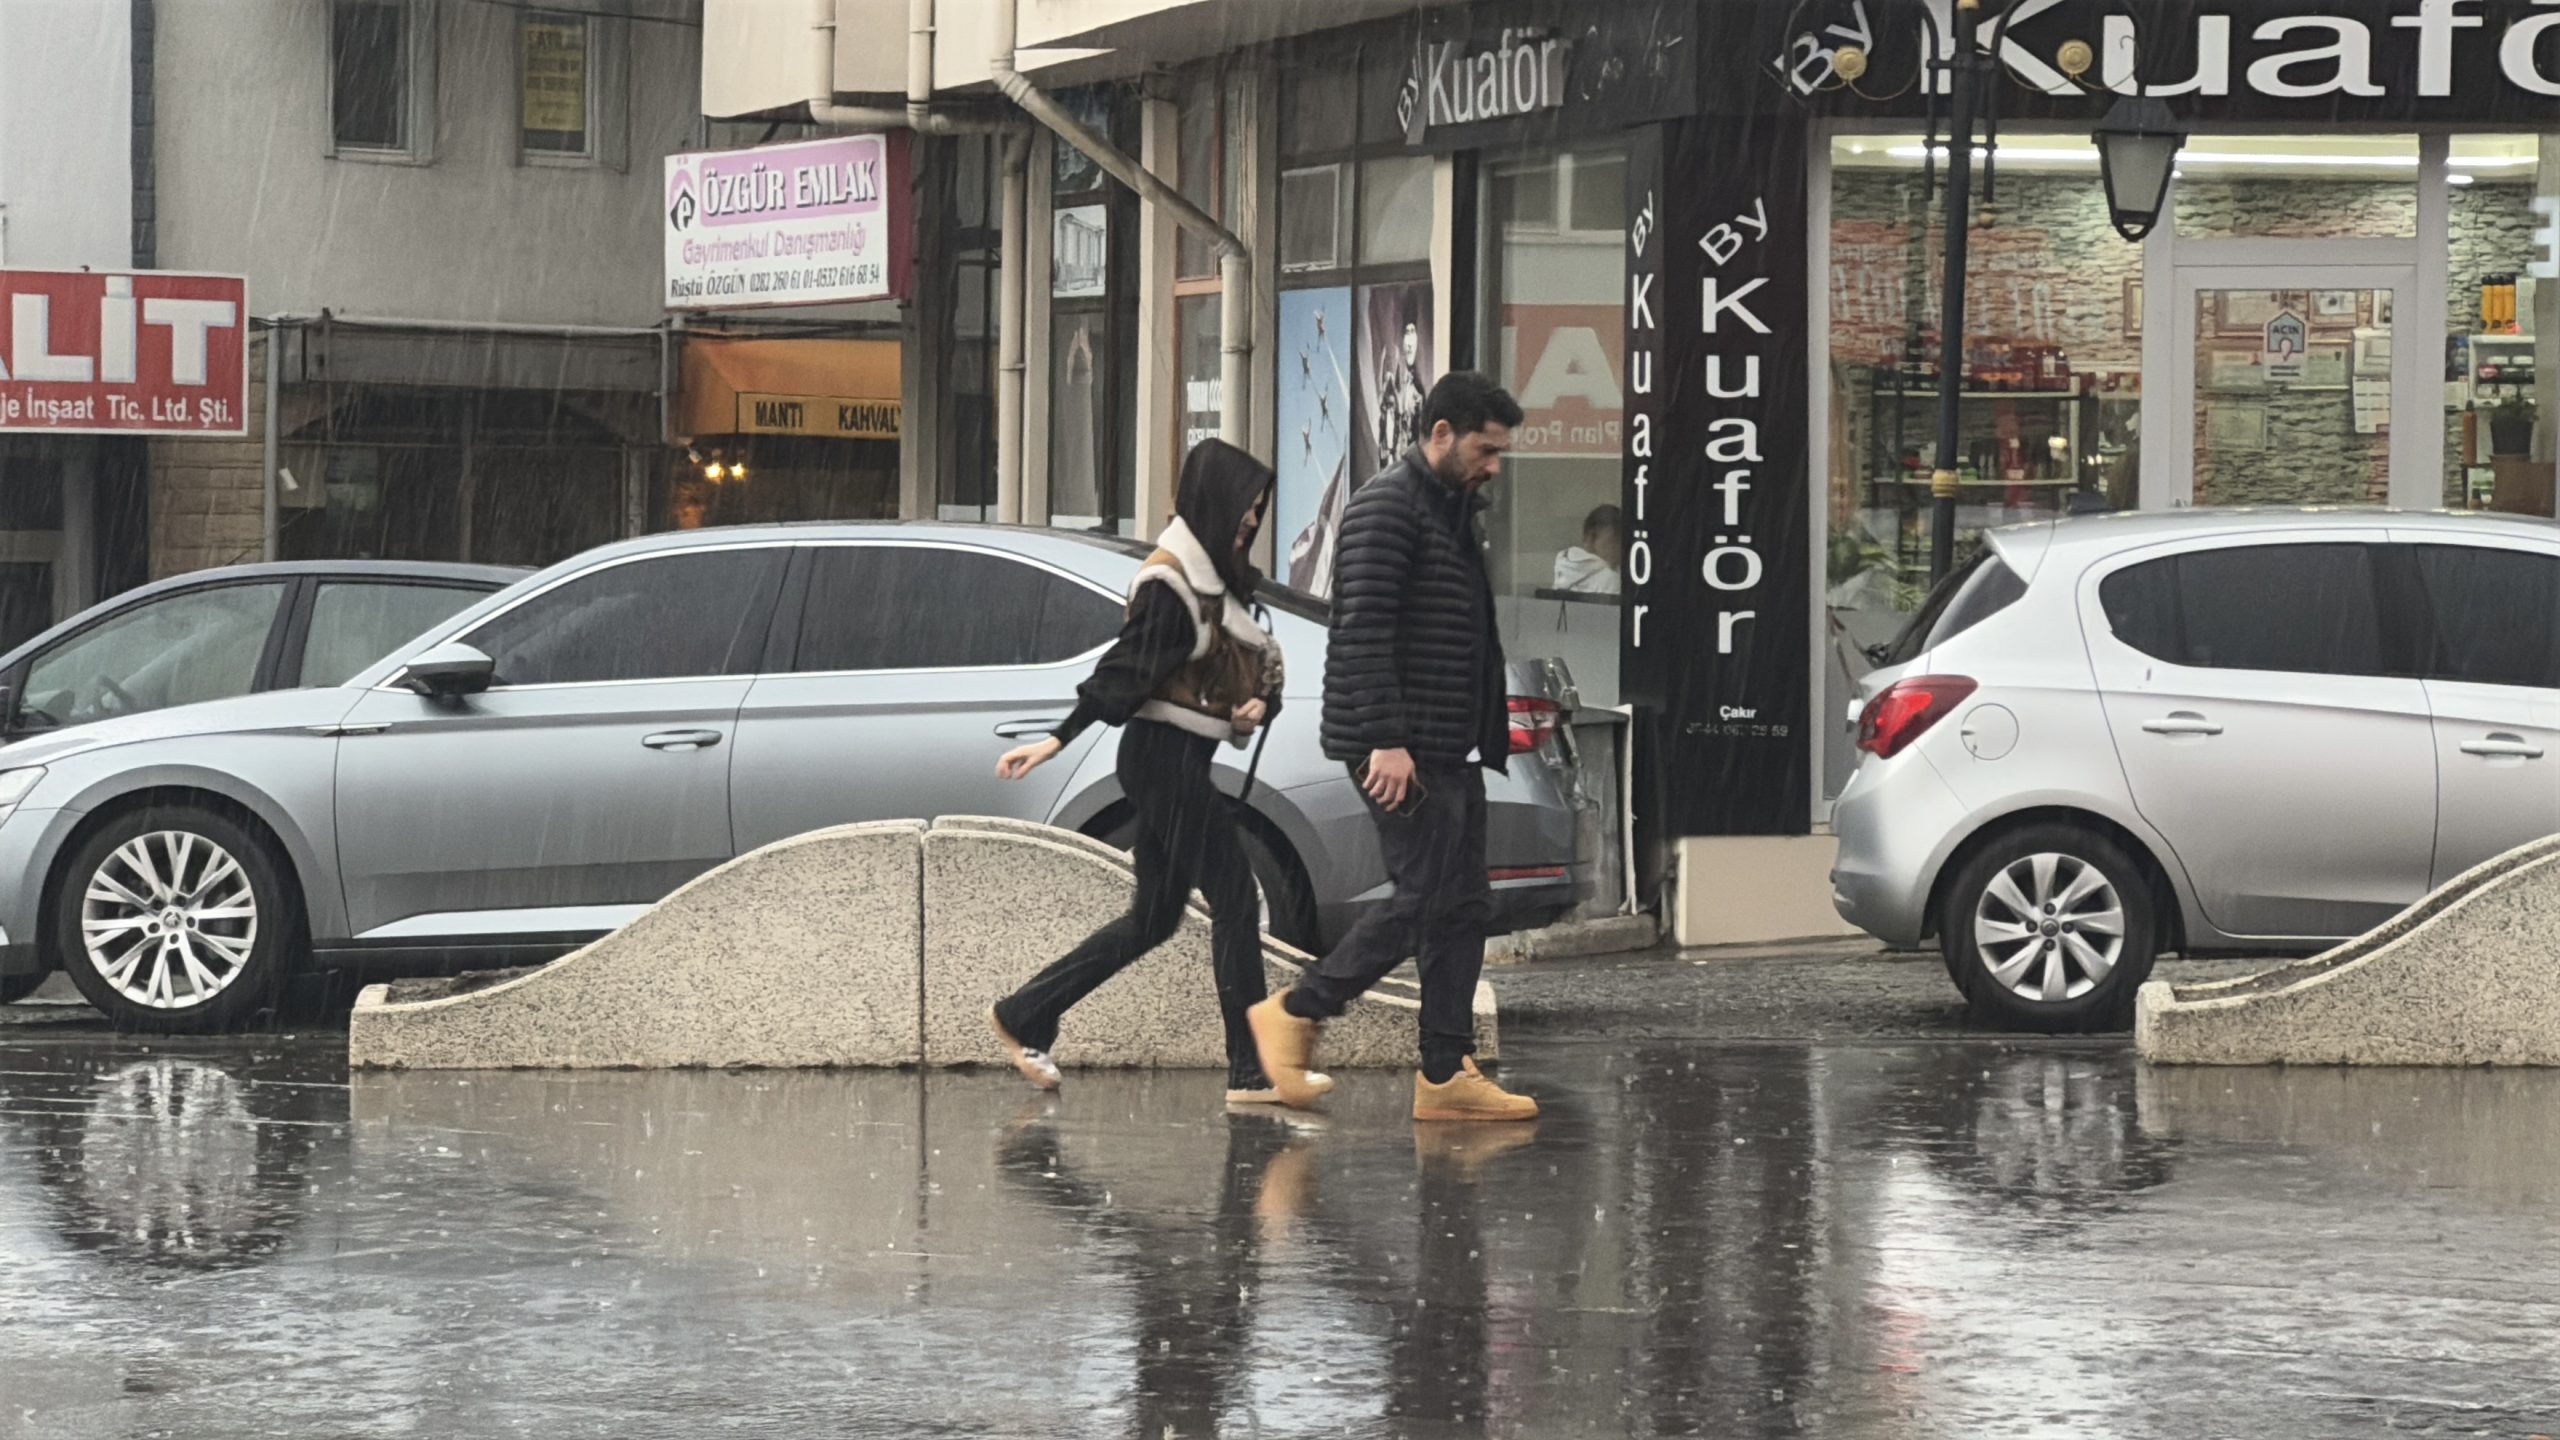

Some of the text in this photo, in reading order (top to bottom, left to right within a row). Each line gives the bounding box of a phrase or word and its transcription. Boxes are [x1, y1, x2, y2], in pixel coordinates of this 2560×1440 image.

[1427, 25, 1556, 126] Kuaför
[702, 160, 878, 217] ÖZGÜR EMLAK
[682, 231, 769, 270] Gayrimenkul
[1699, 196, 1768, 266] By
[0, 275, 236, 385] LİT
[27, 387, 94, 425] İnşaat
[106, 394, 145, 420] Tic.
[152, 396, 192, 422] Ltd.
[199, 397, 233, 428] Şti.
[755, 401, 900, 432] MANTI KAHVAL
[1629, 189, 1655, 648] By Kuaför
[1702, 277, 1773, 654] Kuaför
[1719, 705, 1757, 721] Çakır
